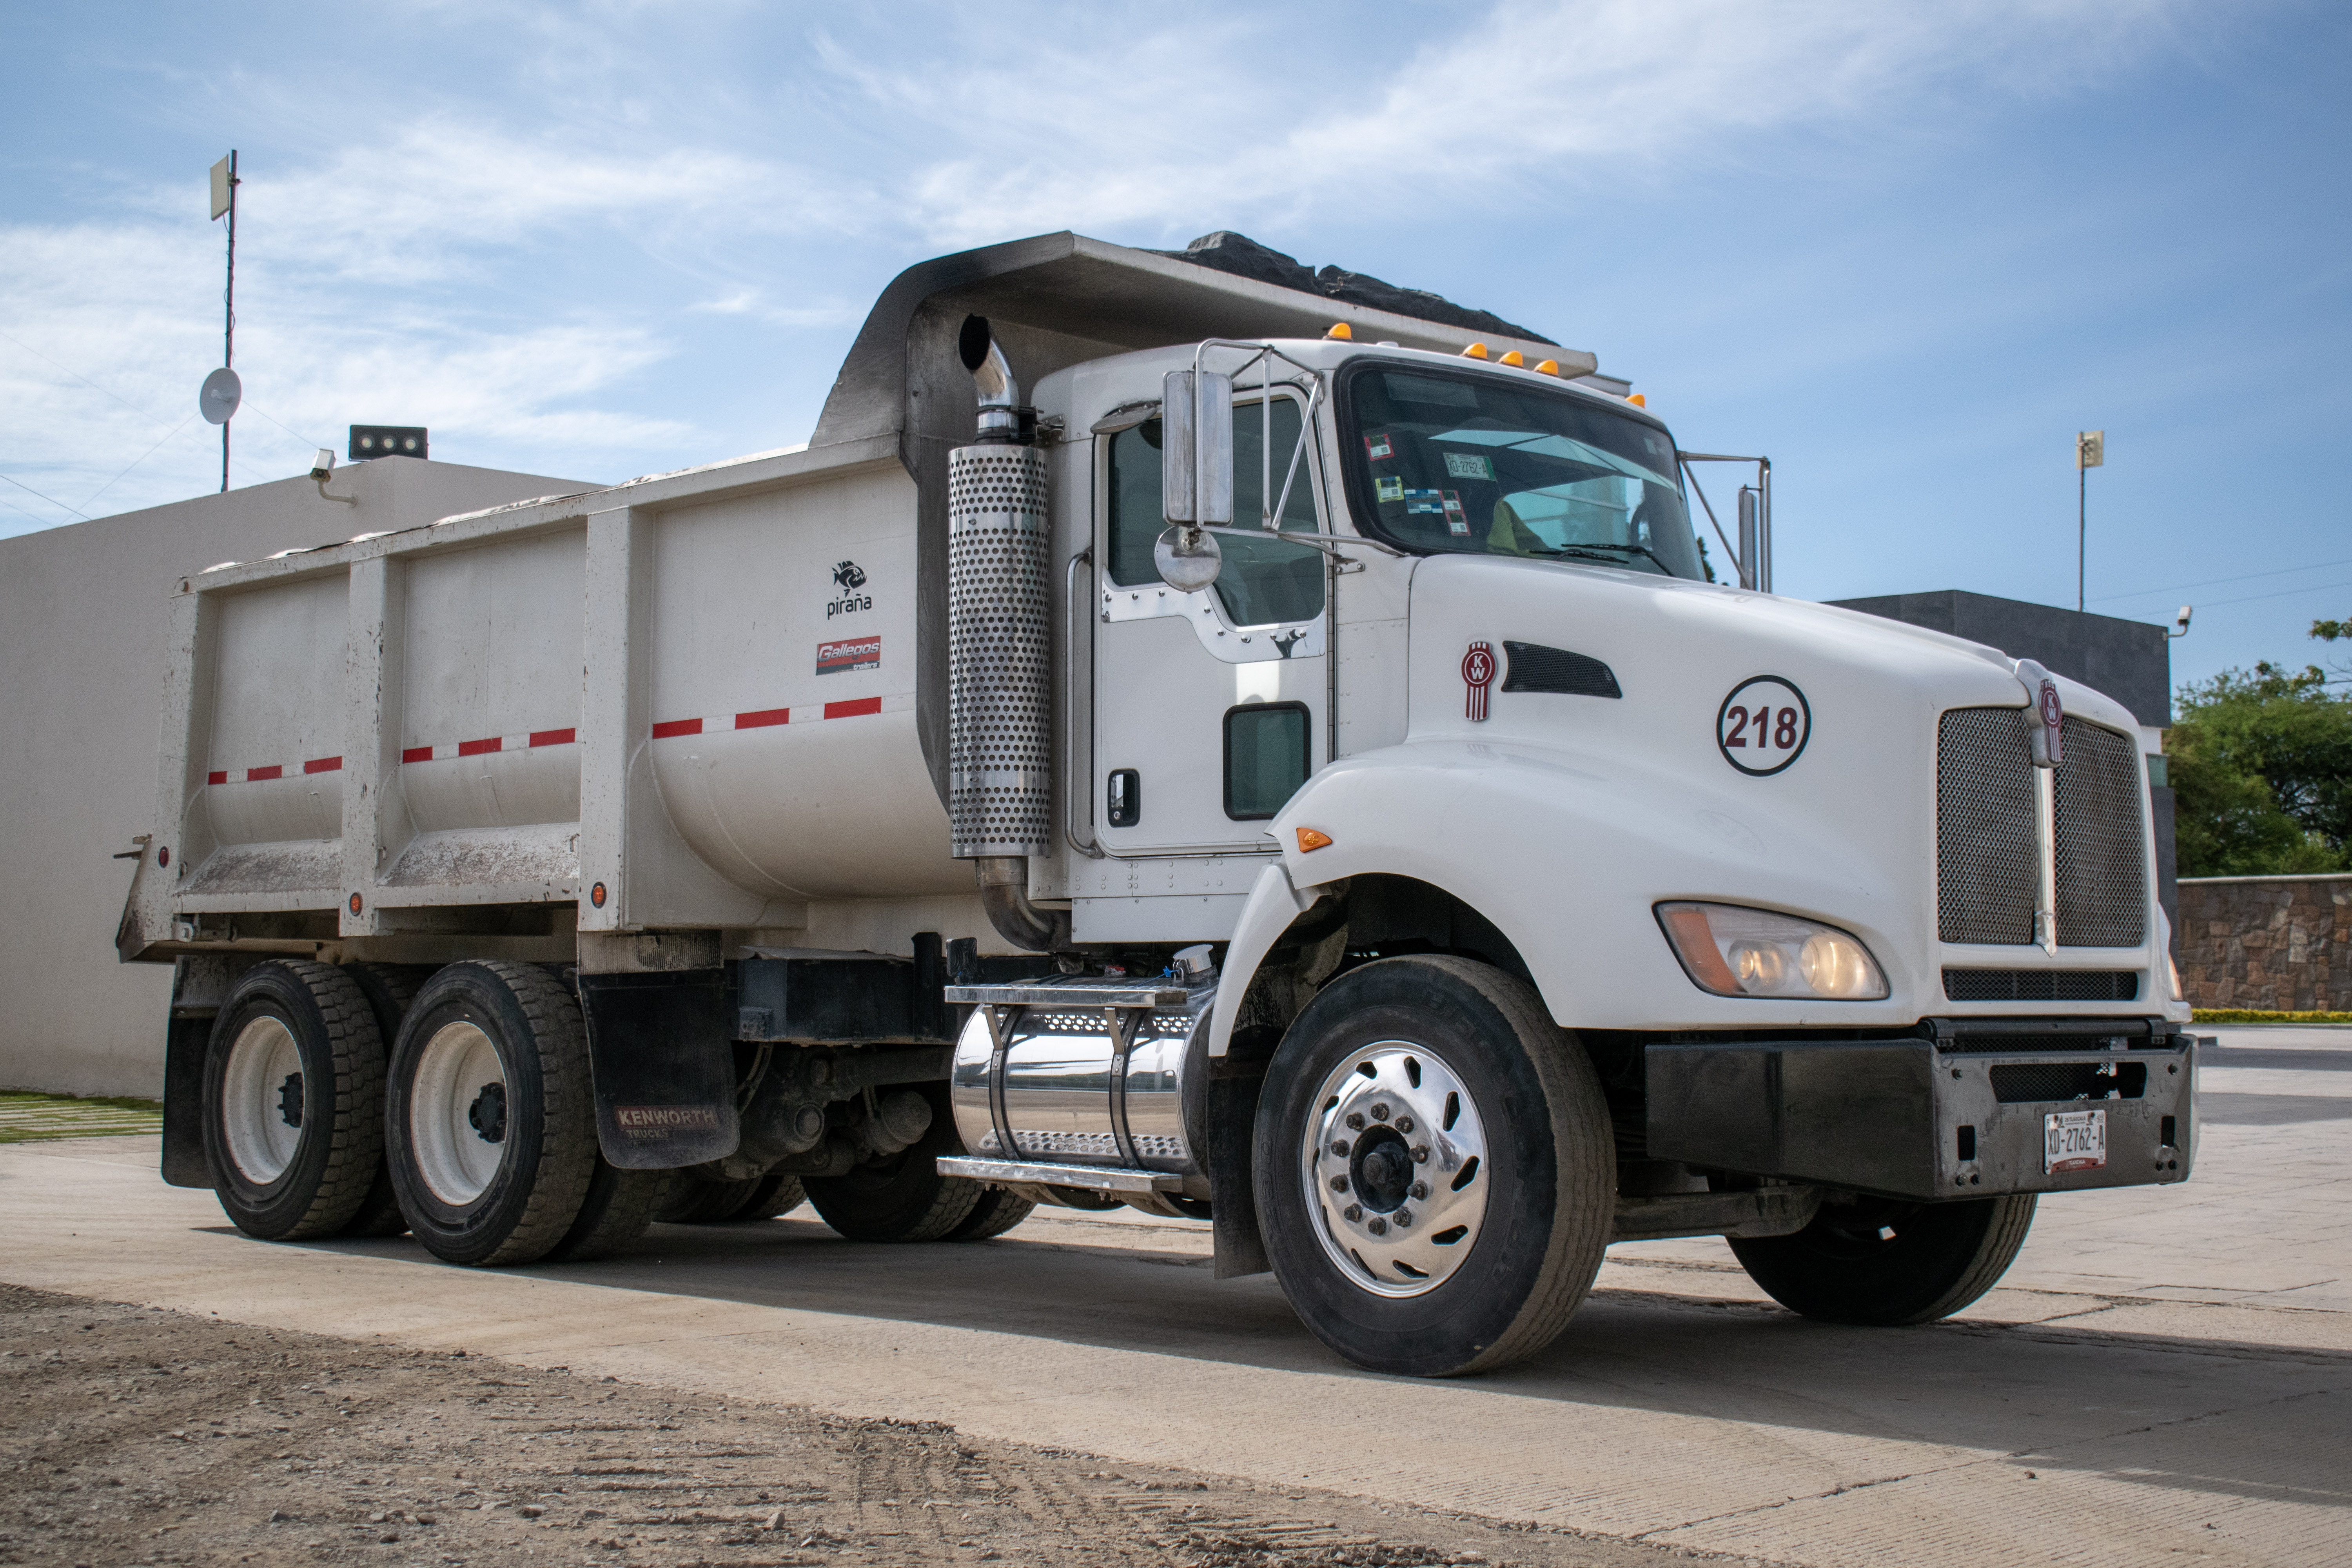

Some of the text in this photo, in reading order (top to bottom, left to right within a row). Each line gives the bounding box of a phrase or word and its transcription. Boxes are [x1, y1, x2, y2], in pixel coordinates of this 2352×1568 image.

[828, 593, 872, 620] piraña
[818, 642, 880, 662] Gallegos
[853, 662, 878, 670] trailers
[1724, 706, 1798, 750] 218
[618, 1110, 717, 1125] KENWORTH
[626, 1129, 669, 1139] TRUCKS
[2047, 1125, 2104, 1155] XD-2762-A
